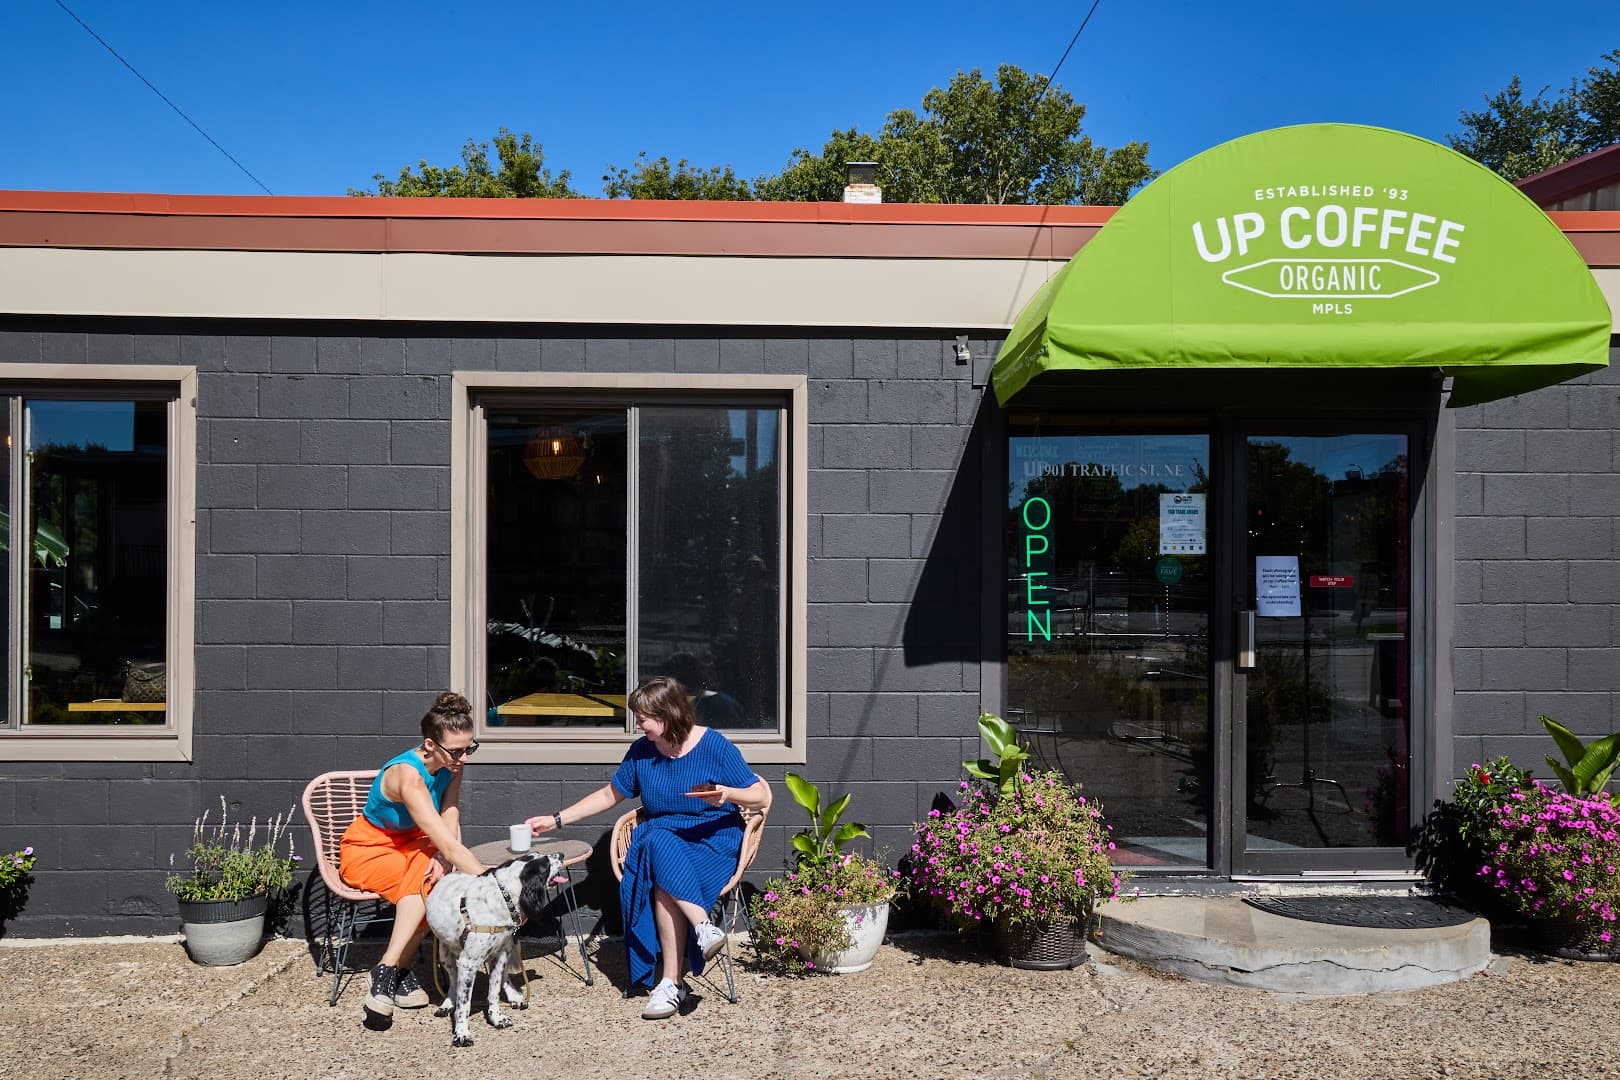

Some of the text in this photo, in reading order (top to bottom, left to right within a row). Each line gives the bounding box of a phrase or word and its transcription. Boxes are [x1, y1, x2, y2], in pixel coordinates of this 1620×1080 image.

[1254, 185, 1409, 201] ESTABLISHED '93
[1192, 204, 1466, 264] UP COFFEE
[1279, 265, 1382, 291] ORGANIC
[1312, 303, 1353, 315] MPLS
[1038, 464, 1185, 477] 1901 TRAFFIC ST. NE
[1022, 496, 1051, 642] OPEN
